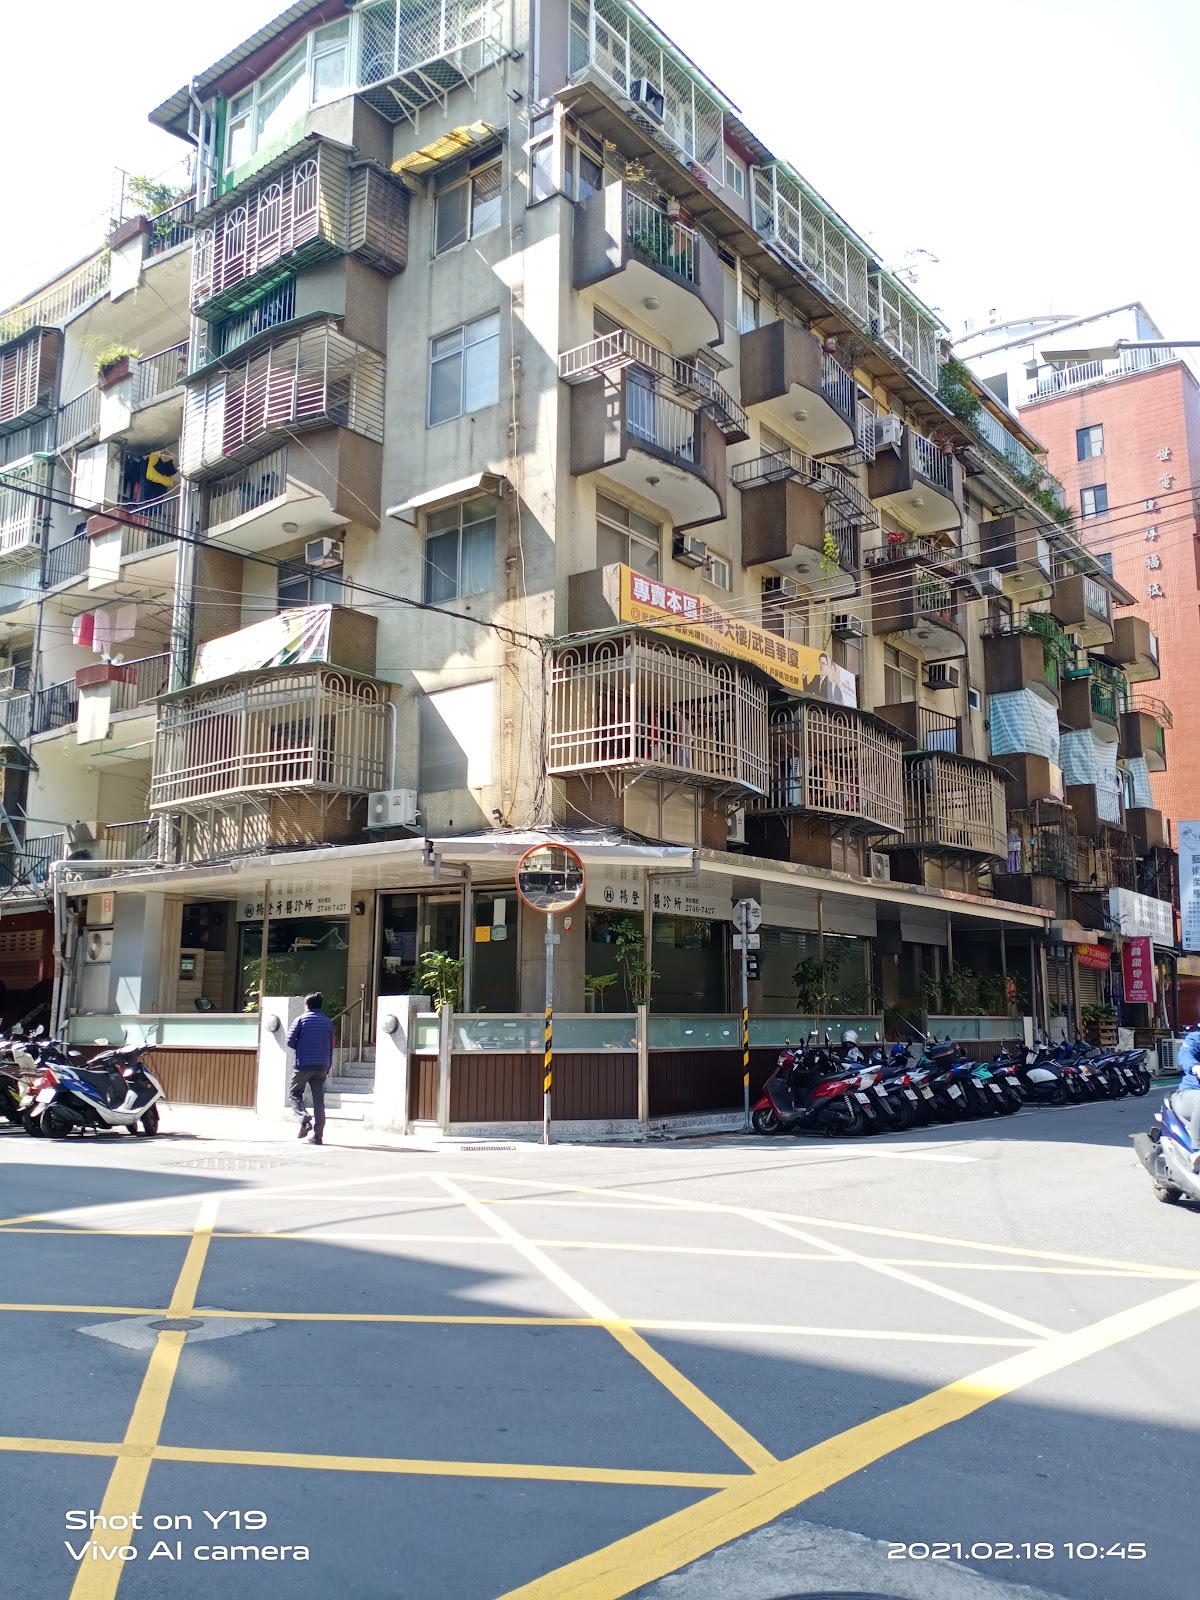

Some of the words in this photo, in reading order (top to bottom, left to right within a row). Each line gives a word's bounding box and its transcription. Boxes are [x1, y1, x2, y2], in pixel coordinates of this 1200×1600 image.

[633, 576, 698, 620] 專賣本區
[317, 903, 347, 913] 2746-7427
[619, 889, 682, 911] 楊登醫診所
[685, 905, 715, 915] 2746-7427
